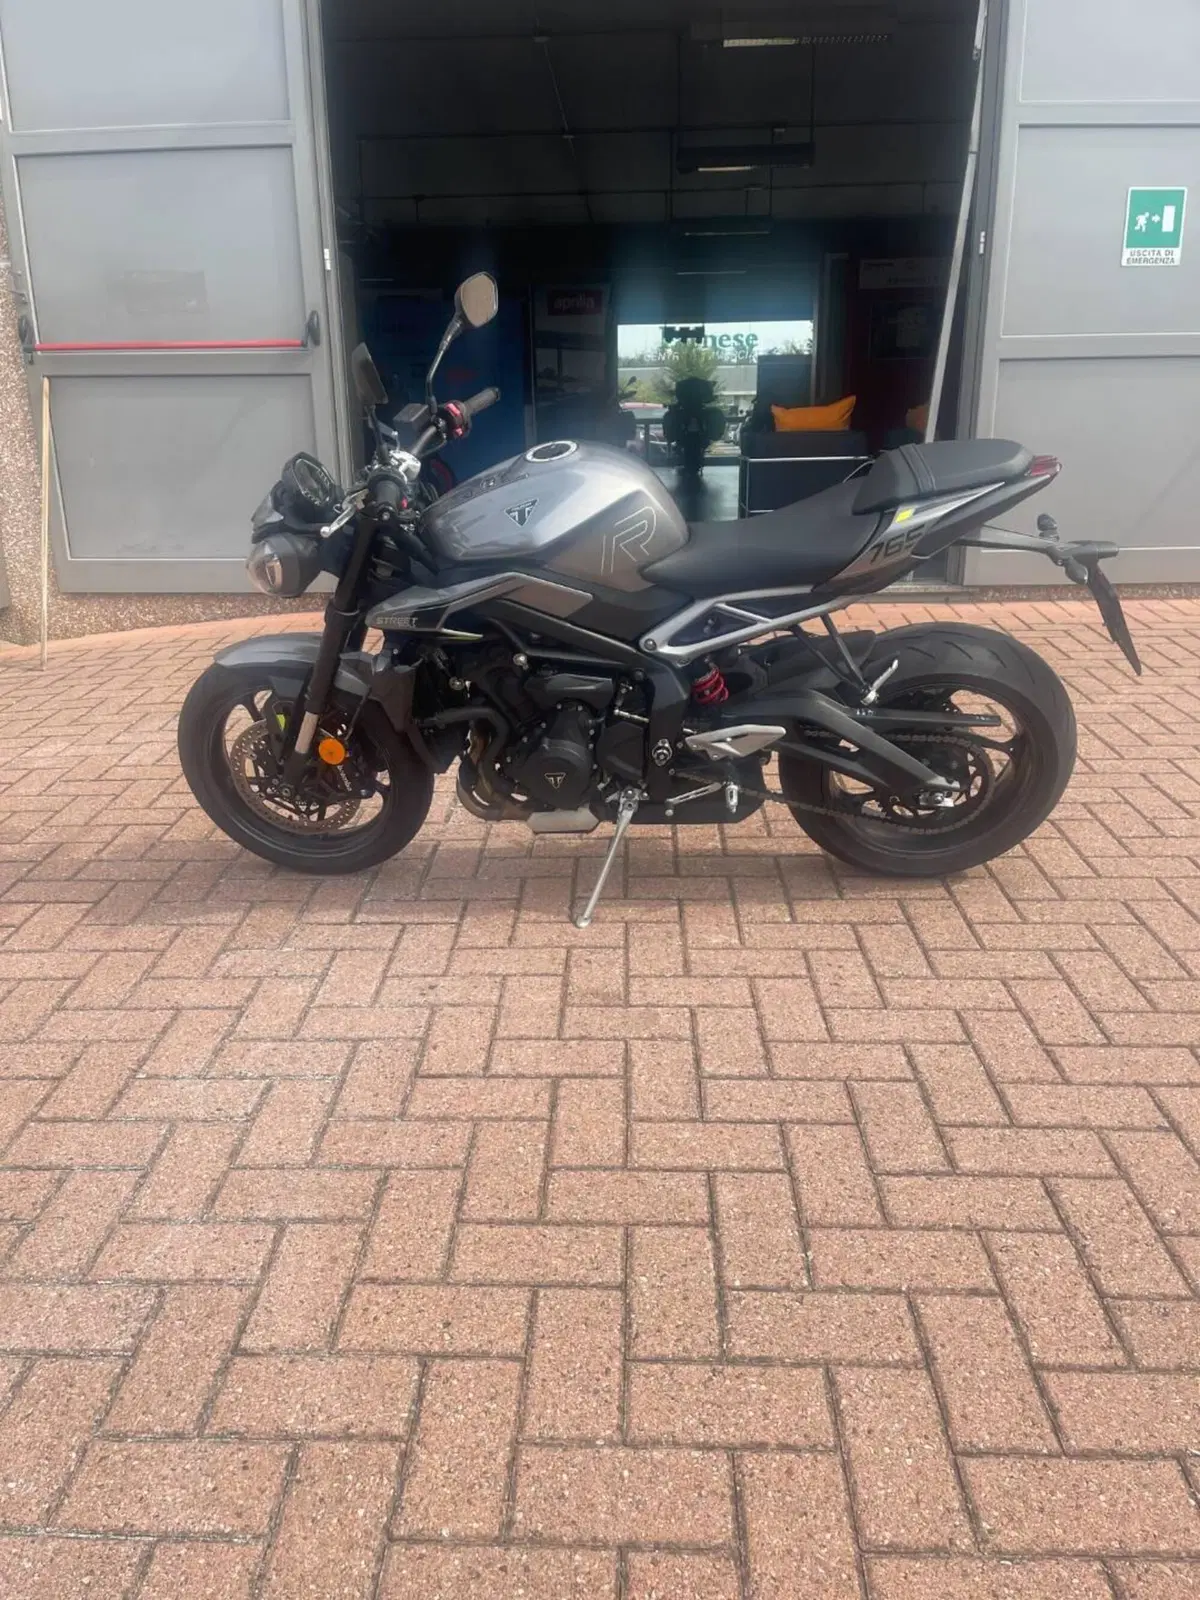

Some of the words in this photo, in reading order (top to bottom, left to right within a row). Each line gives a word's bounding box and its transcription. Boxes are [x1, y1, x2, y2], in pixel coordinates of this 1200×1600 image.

[1130, 249, 1162, 257] USCITA
[1164, 249, 1174, 257] DI
[1126, 257, 1175, 265] EMERGENZA
[643, 350, 682, 362] CENTR
[869, 523, 926, 564] 765
[376, 616, 419, 627] STREET
